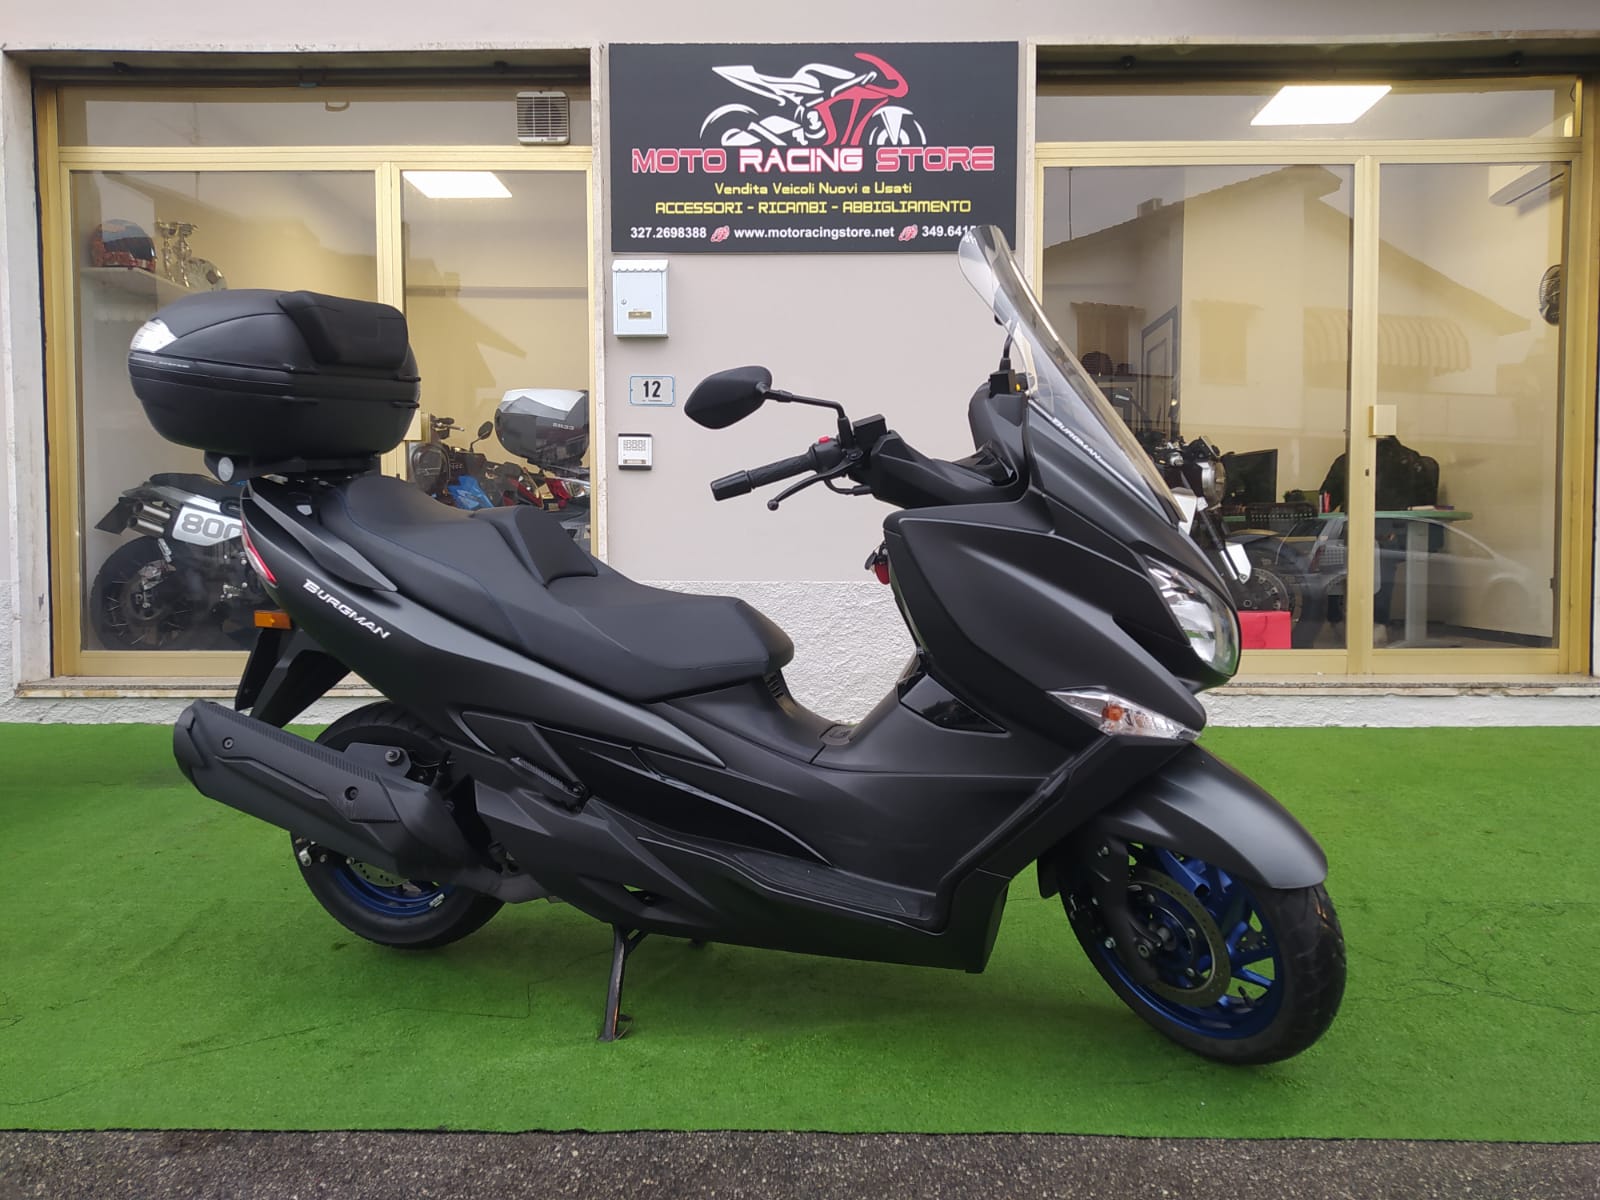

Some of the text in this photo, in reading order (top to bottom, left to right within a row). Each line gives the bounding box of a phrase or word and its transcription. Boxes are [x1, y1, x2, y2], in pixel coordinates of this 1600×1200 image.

[631, 146, 995, 173] MOTO RACING STORE
[714, 182, 913, 194] Vendita Veicoli Nuovi e Usati
[655, 202, 744, 214] ACCESSORI
[757, 201, 828, 214] RICAMBI
[842, 200, 972, 213] ABBIGLIAMENTO
[630, 227, 707, 239] 327.2698388
[734, 226, 895, 240] www.motoracingstore.net
[642, 380, 662, 398] 12
[302, 578, 391, 639] BURGMAN
